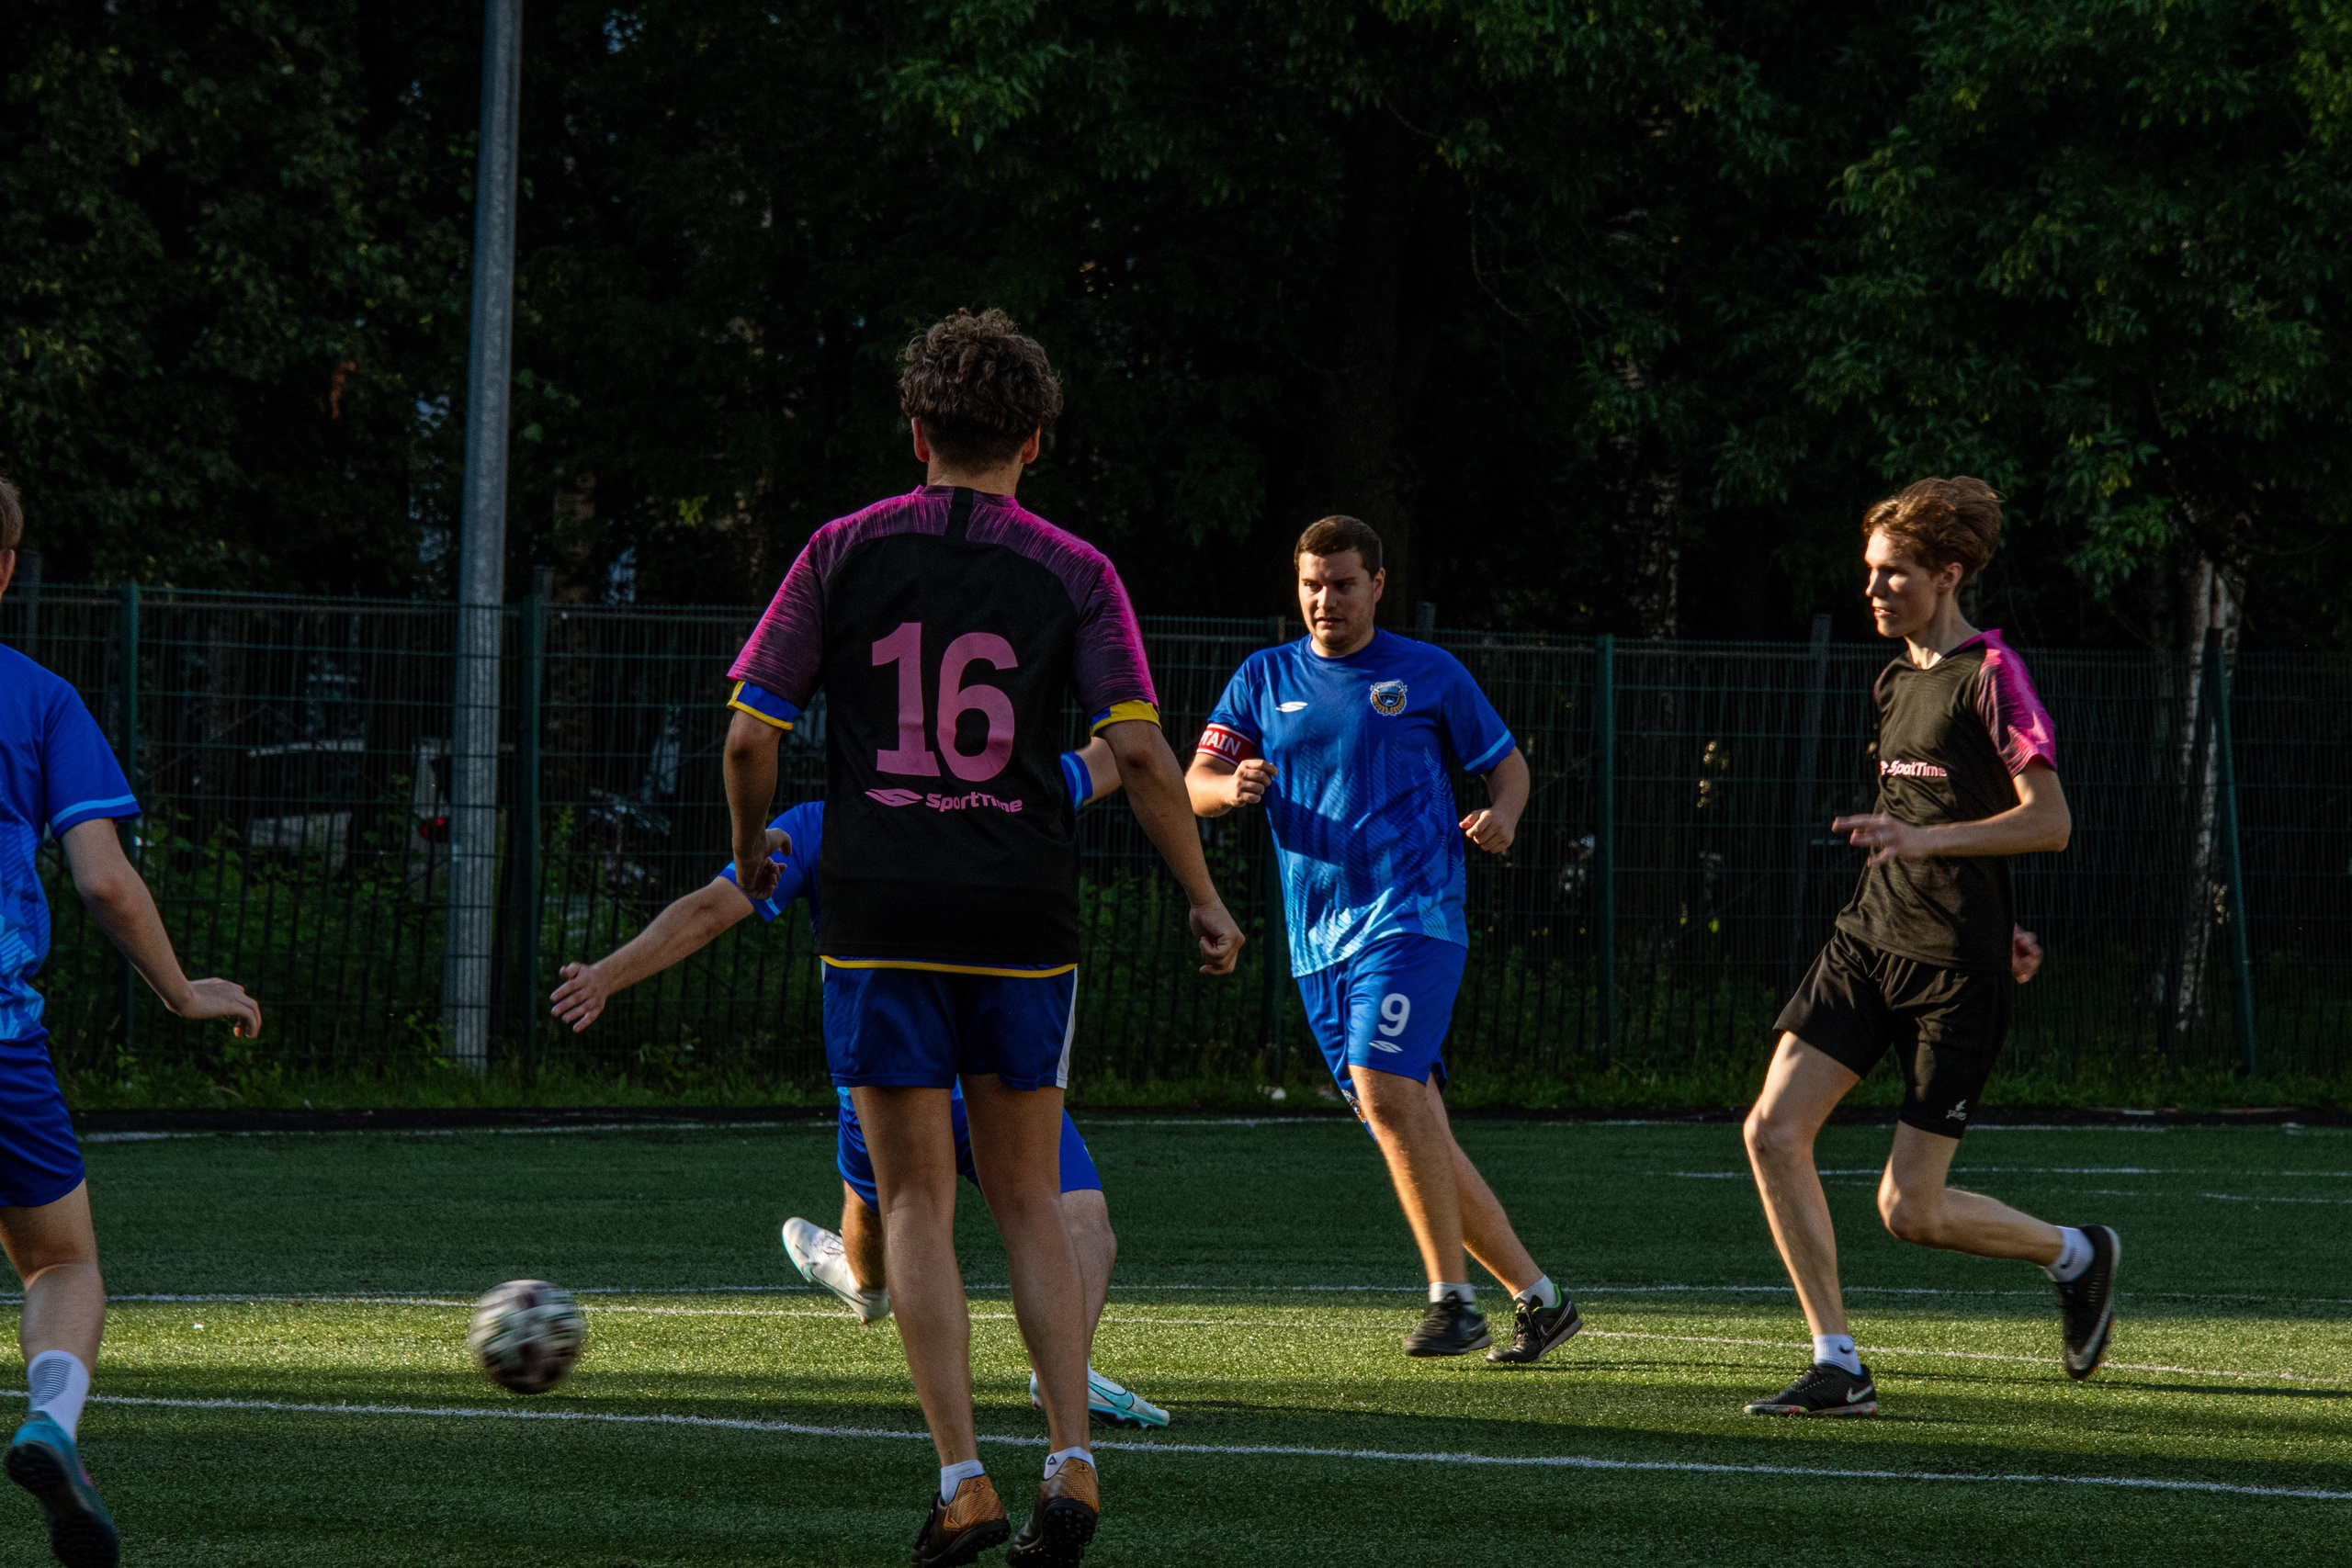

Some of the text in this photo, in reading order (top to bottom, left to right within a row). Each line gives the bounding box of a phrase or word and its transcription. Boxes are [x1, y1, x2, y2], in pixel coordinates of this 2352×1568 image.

[872, 622, 1019, 782] 16
[1199, 730, 1241, 756] TAIN
[1886, 760, 1948, 777] SpotTime
[924, 791, 1023, 813] SportTime
[1378, 993, 1410, 1036] 9
